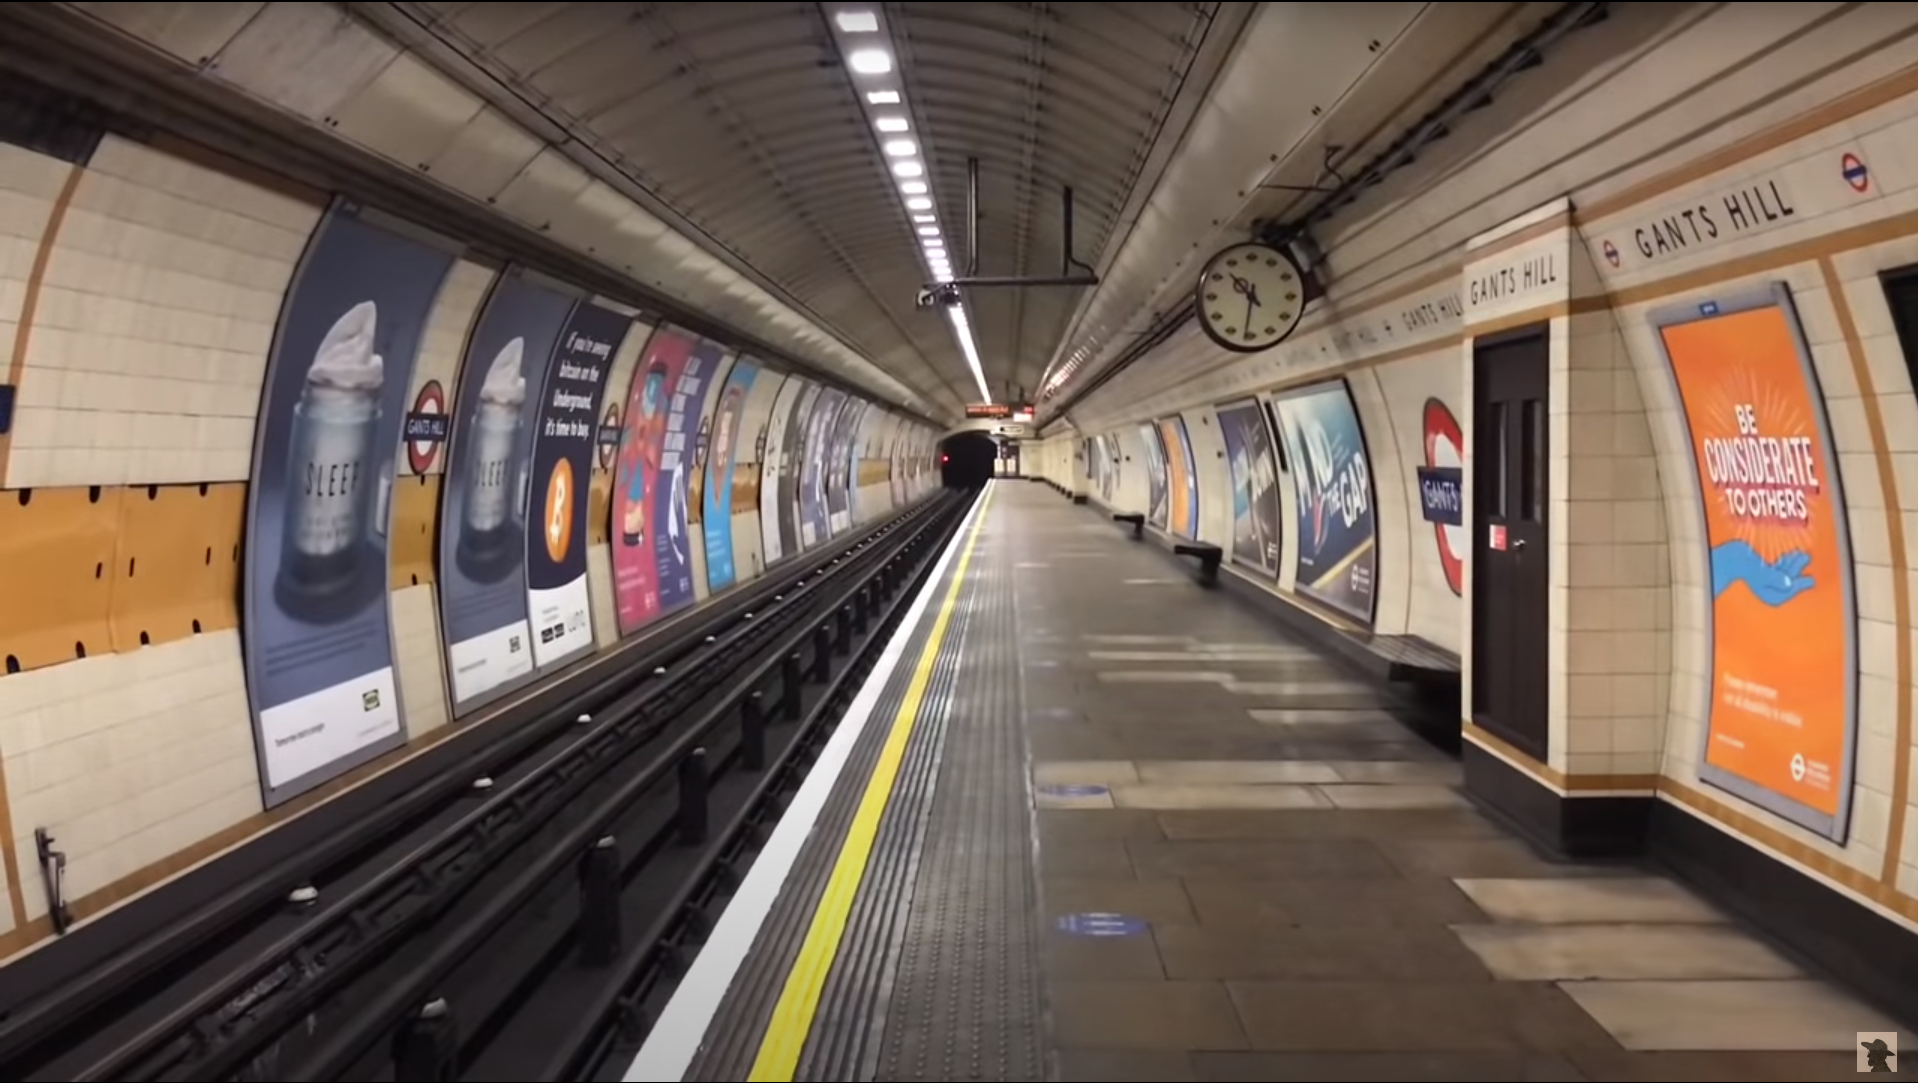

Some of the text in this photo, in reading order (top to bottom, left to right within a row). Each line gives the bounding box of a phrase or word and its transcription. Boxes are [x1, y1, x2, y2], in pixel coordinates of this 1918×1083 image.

[1635, 180, 1794, 259] GANTS HILL
[1471, 253, 1556, 305] GANTS HILL
[1402, 303, 1439, 331] GANTS
[408, 419, 444, 435] GANTS HILL
[555, 418, 570, 437] time
[570, 419, 577, 437] to
[1735, 404, 1758, 434] BE
[1704, 437, 1819, 487] CONSIDERATE
[1340, 451, 1368, 530] GAP
[1424, 480, 1459, 512] GANTS
[1726, 488, 1807, 520] TO OTHERS
